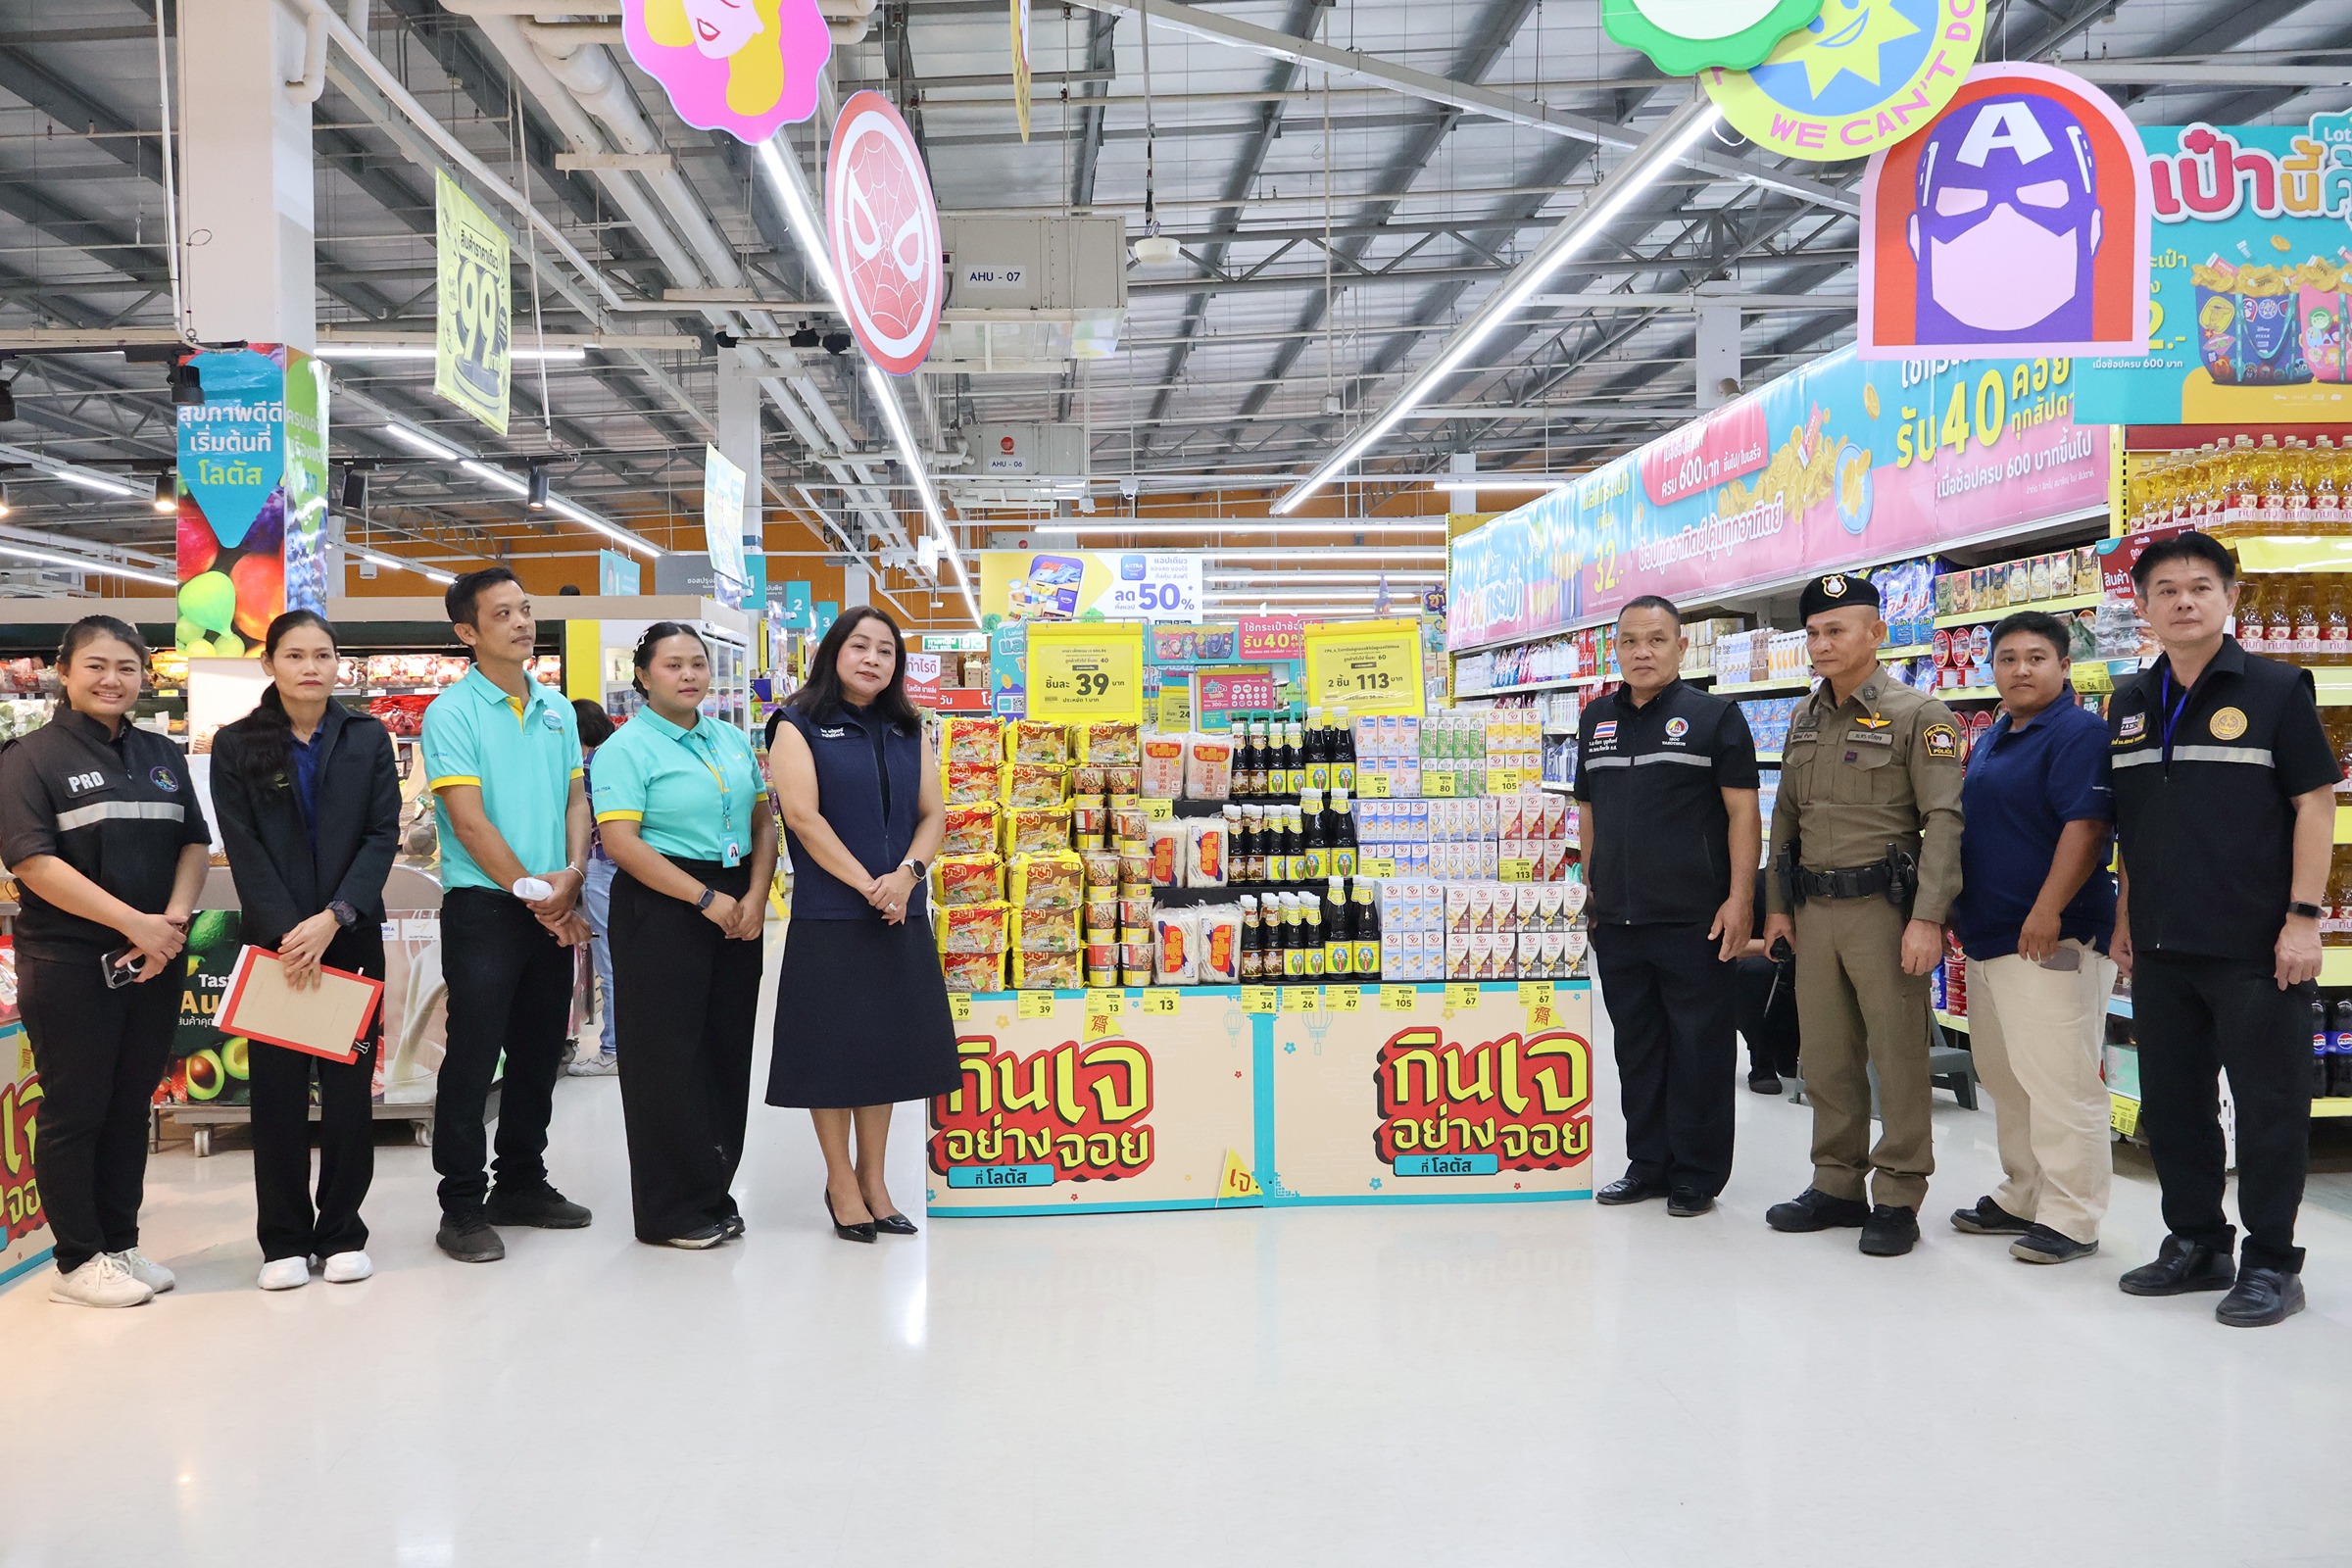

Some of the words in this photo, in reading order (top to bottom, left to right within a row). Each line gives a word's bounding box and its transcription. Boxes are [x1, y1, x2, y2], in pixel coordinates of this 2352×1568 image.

[1770, 113, 1829, 149] WE
[1839, 49, 1955, 146] CAN'T
[2324, 126, 2352, 142] Lot
[969, 271, 994, 282] AHU
[1006, 271, 1021, 282] 07
[460, 260, 497, 370] 99
[2143, 358, 2164, 368] 600
[2166, 360, 2183, 369] บาท
[178, 400, 283, 429] สุขภาพดีดี
[1896, 406, 1937, 469] รับ
[1940, 368, 2006, 455] 40
[190, 423, 271, 452] เริ่มต้นที่
[198, 459, 263, 485] โลตัส
[2006, 452, 2032, 480] 600
[1661, 476, 1678, 499] ครบ
[1679, 455, 1703, 491] 600
[1703, 458, 1720, 481] บาท
[1639, 516, 1707, 575] ช้อปทุกอาทิตย์
[1707, 491, 1785, 561] คุ้มทุกอาทิตย์
[1153, 556, 1188, 565] แอปเดียว
[2104, 568, 2130, 587] สินค้า
[793, 598, 803, 611] 2
[1114, 590, 1136, 602] ลด
[822, 616, 831, 628] 3
[1244, 634, 1262, 648] รับ
[1264, 633, 1290, 648] 40
[906, 683, 921, 693] โลตัส
[921, 685, 937, 694] ขายส่ง
[1045, 675, 1070, 689] ชิ้นละ
[1075, 672, 1109, 696] 39
[1328, 679, 1335, 688] 2
[1337, 673, 1349, 687] ชิ้น
[1356, 672, 1390, 690] 113
[68, 770, 106, 793] PRD
[1153, 808, 1166, 818] 37
[180, 990, 220, 1013] Au
[1108, 1004, 1119, 1012] 13
[1159, 1000, 1174, 1010] 13
[1261, 1001, 1273, 1009] 34
[1302, 1000, 1314, 1008] 26
[1346, 1000, 1356, 1008] 47
[1396, 999, 1412, 1007] 105
[1465, 997, 1476, 1005] 67
[1539, 995, 1549, 1004] 67
[957, 1007, 969, 1016] 39
[948, 1040, 1149, 1125] กินเจ
[1392, 1032, 1589, 1115] กินเจ
[1392, 1102, 1589, 1158] อย่างจอย
[946, 1112, 1150, 1168] อย่างจอย
[1421, 1160, 1430, 1174] ที่
[1432, 1156, 1473, 1174] โลตัส
[975, 1170, 984, 1185] ที่
[986, 1166, 1028, 1185] โลตัส
[1229, 1167, 1251, 1193] เจ
